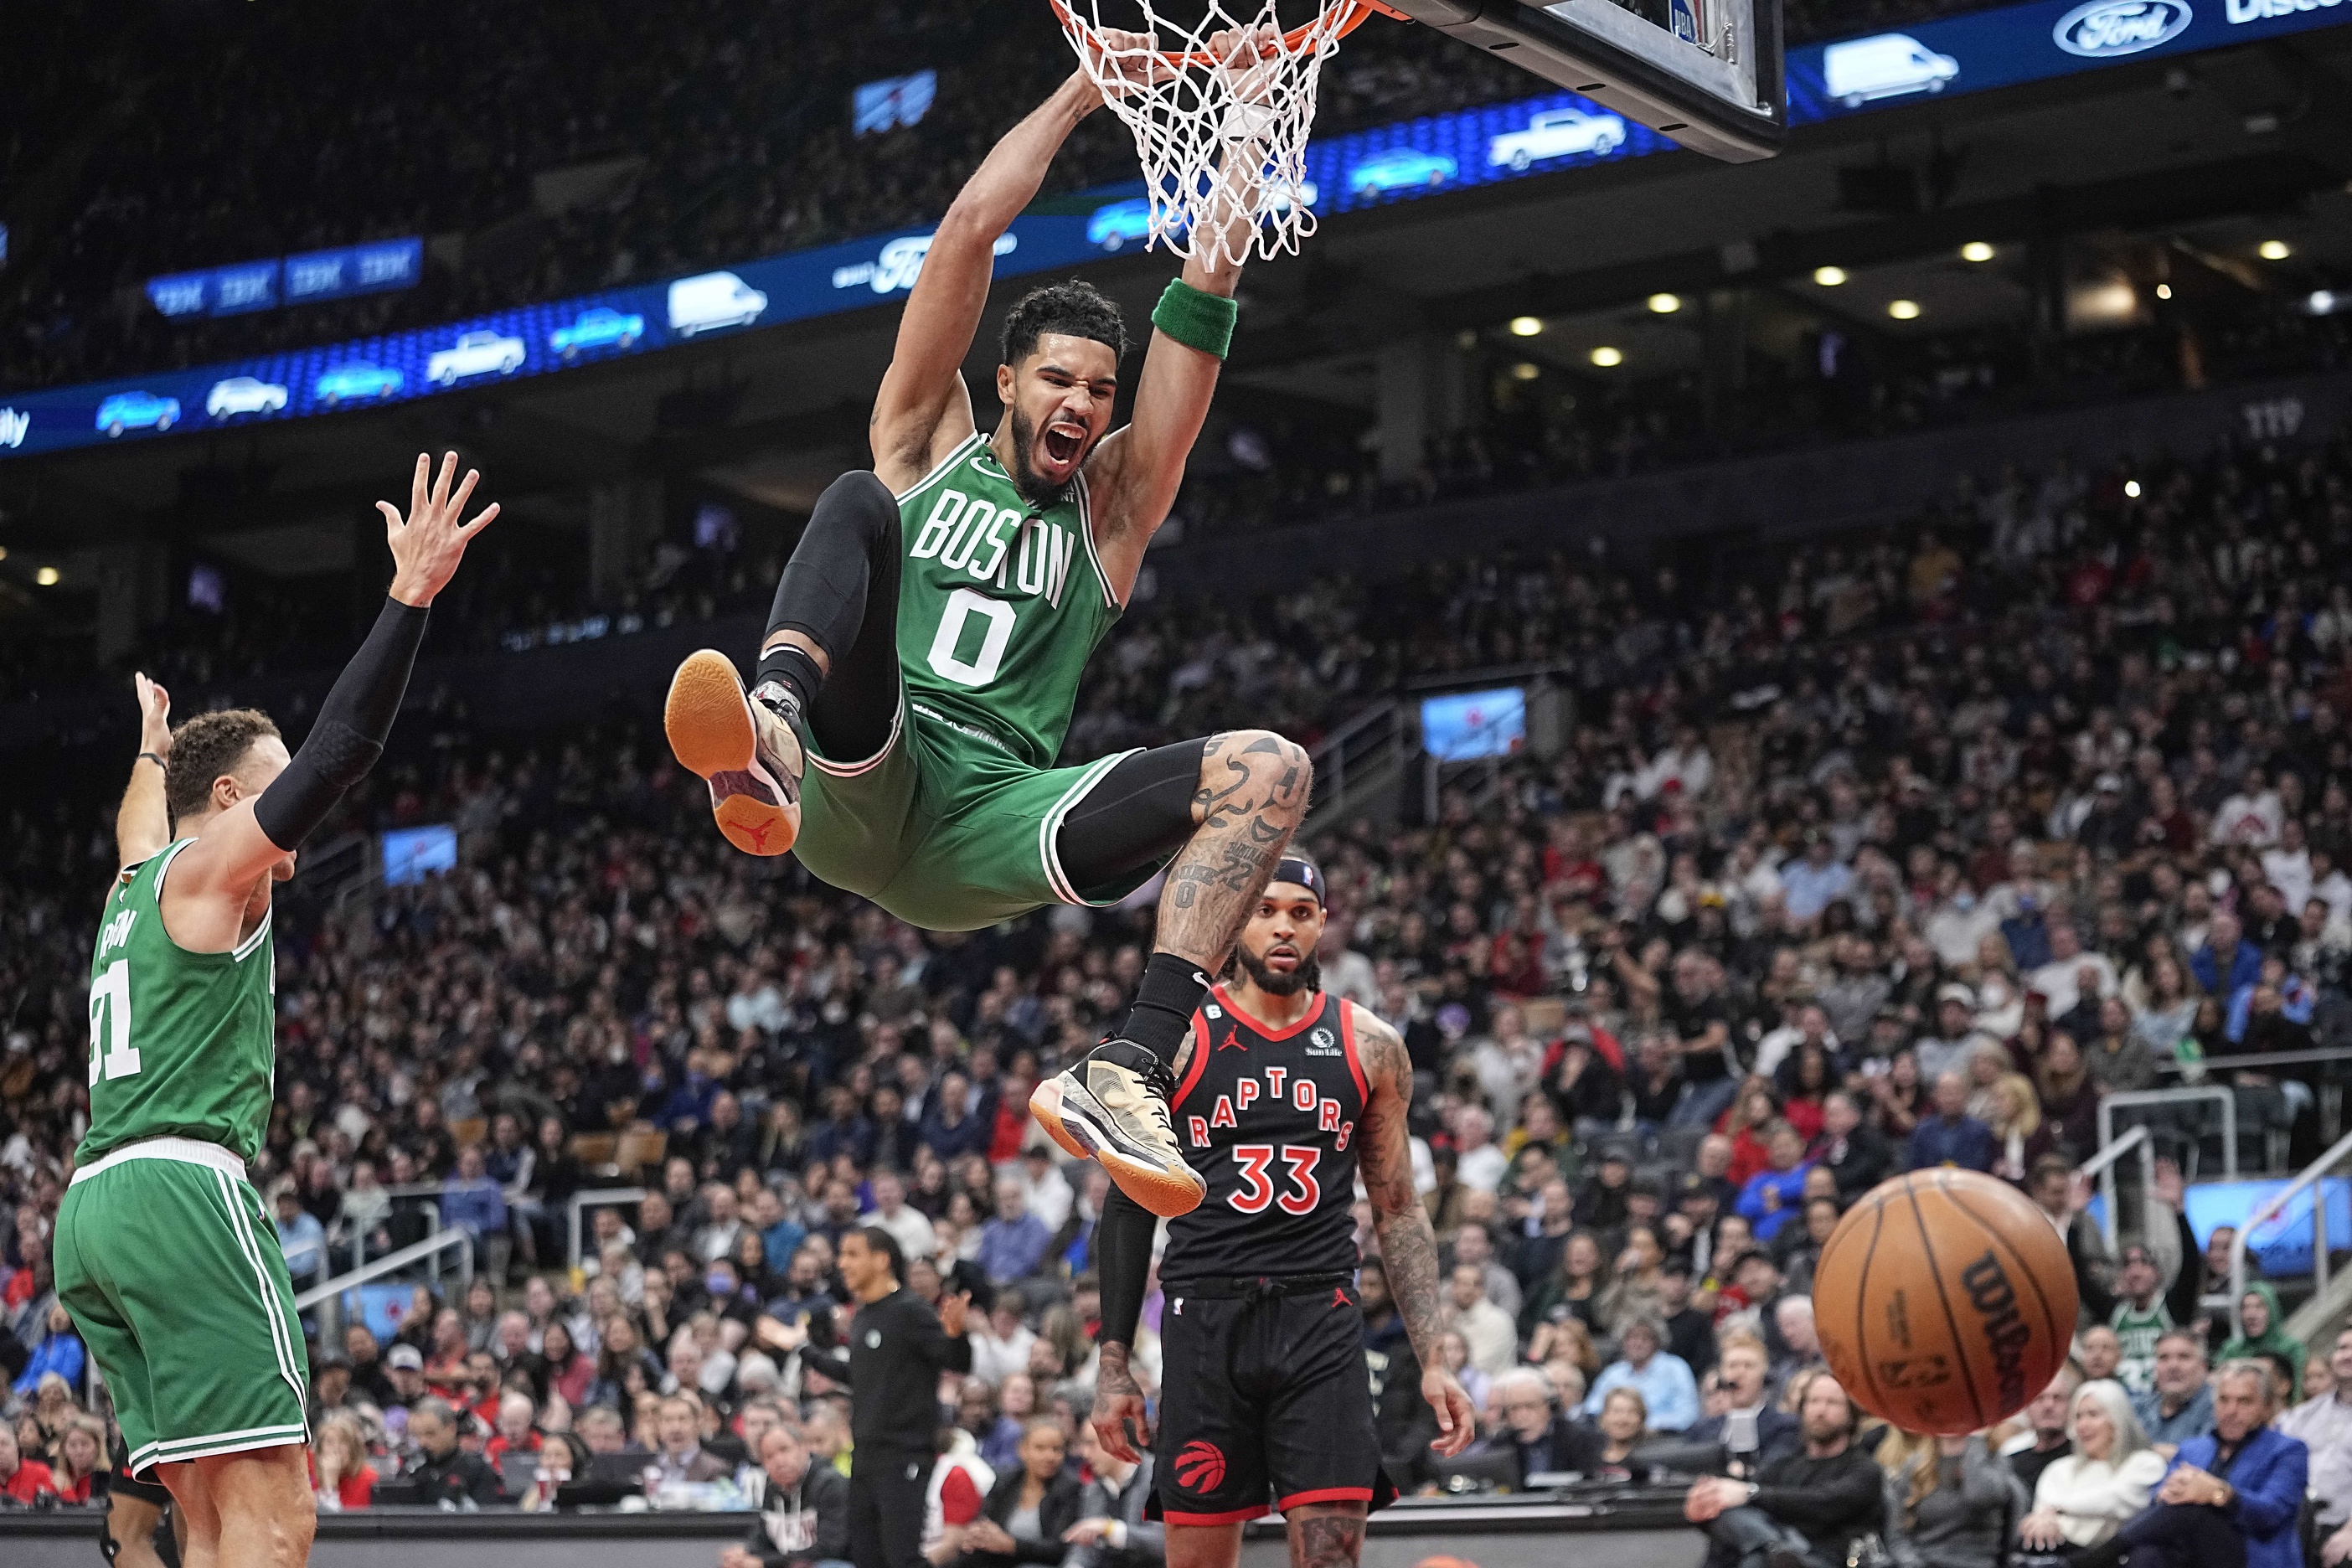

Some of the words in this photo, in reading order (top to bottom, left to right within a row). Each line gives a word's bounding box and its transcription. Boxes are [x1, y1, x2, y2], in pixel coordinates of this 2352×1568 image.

[1674, 8, 1693, 39] NBA
[2076, 1, 2169, 49] Ford
[926, 586, 1017, 687] 0
[1175, 882, 1197, 909] 0
[1205, 1004, 1222, 1019] 6
[1305, 1047, 1324, 1056] Sun
[1324, 1047, 1343, 1057] Life
[1188, 1066, 1354, 1152] RAPTORS
[1227, 1144, 1321, 1215] 33
